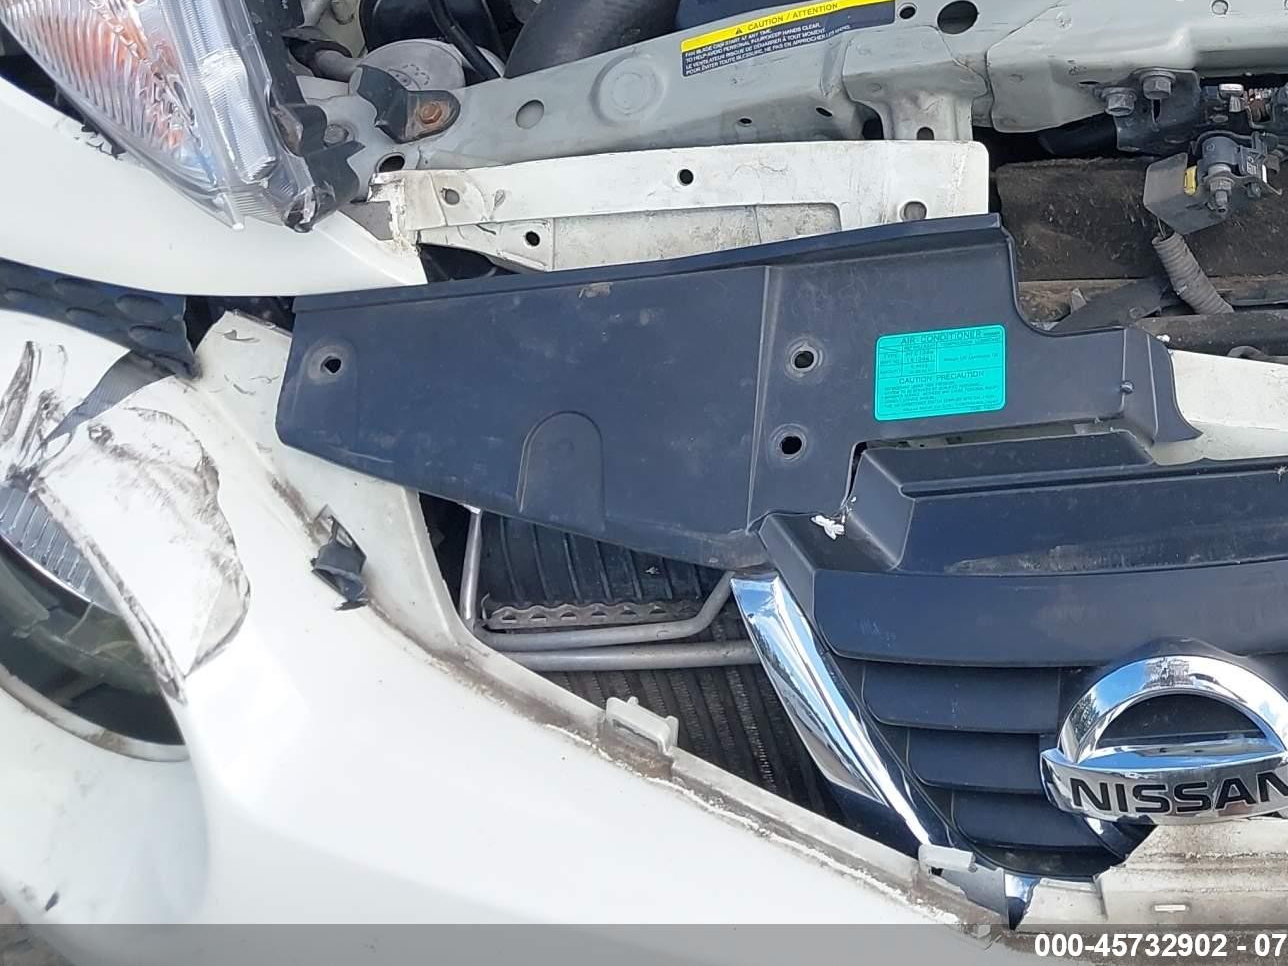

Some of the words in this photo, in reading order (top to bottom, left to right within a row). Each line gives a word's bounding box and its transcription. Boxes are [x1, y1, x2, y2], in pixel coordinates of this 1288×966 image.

[747, 16, 784, 31] CAUTION
[792, 2, 838, 19] ATTENTION
[900, 337, 916, 345] AIR
[920, 330, 983, 343] CONDITIONER
[899, 376, 932, 385] CAUTION
[936, 370, 985, 381] PRECAUTION
